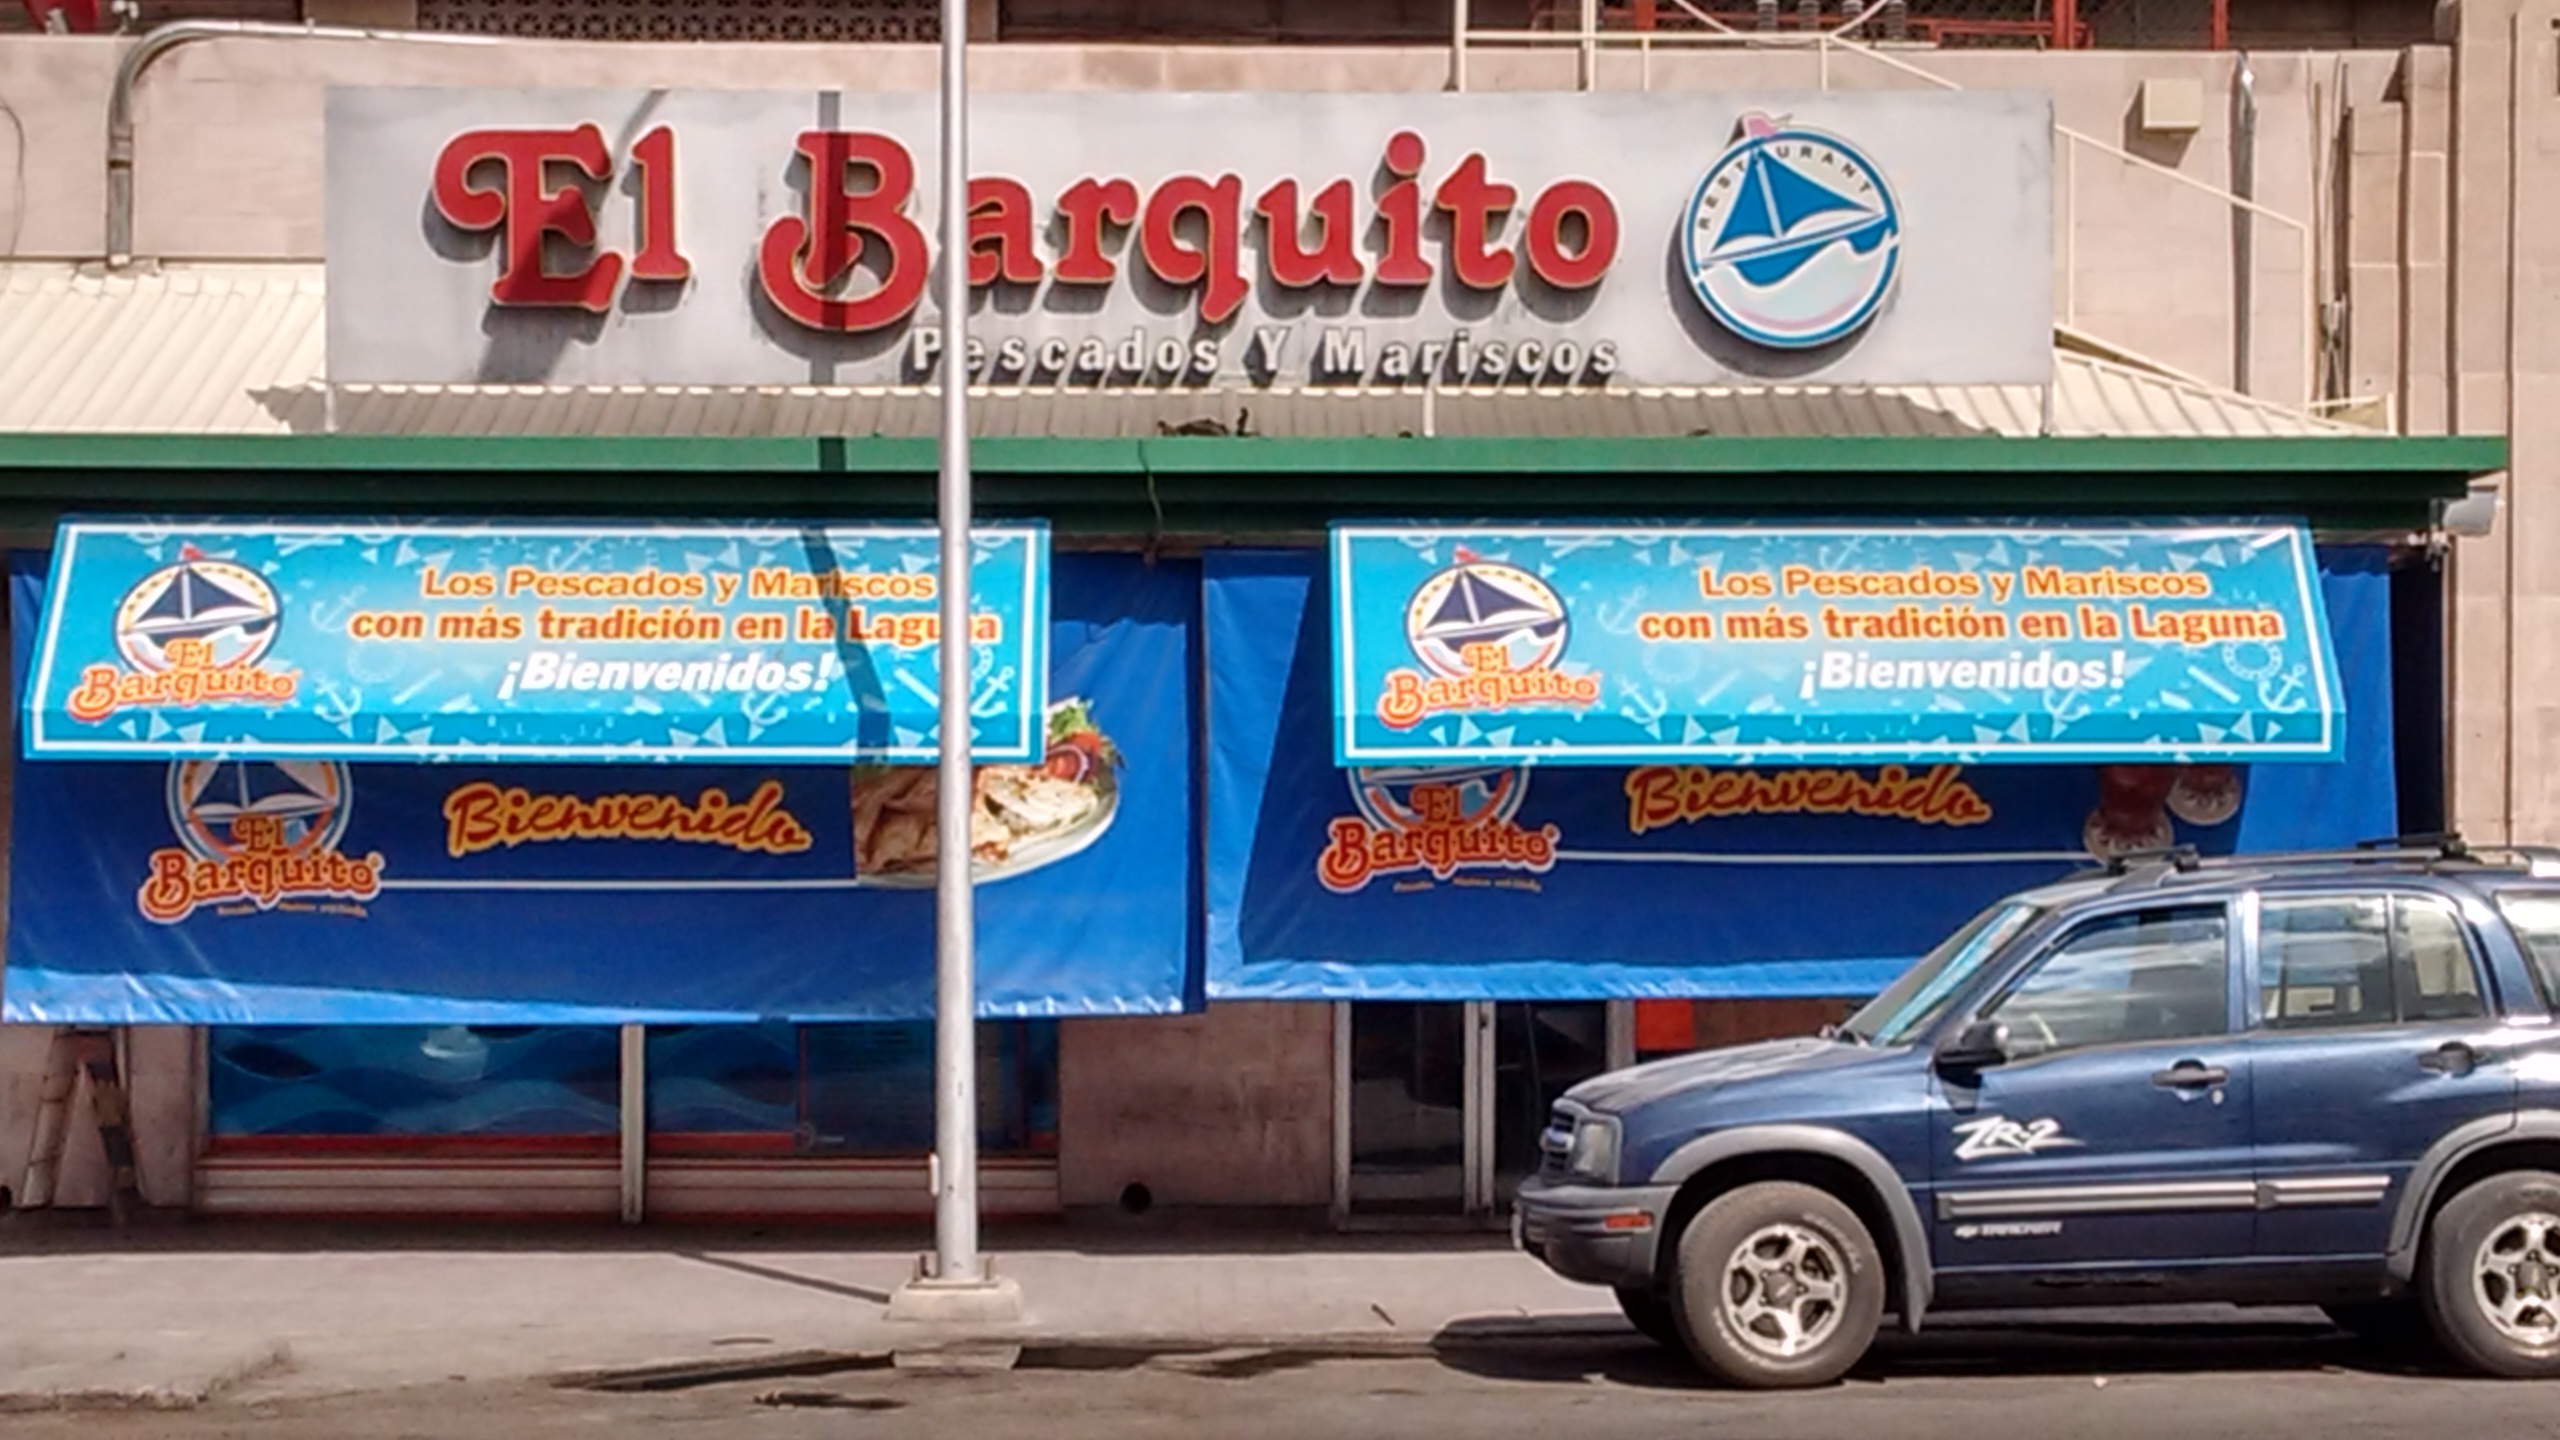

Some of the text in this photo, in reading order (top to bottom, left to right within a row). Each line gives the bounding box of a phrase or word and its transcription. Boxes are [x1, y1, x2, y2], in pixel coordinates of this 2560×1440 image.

[433, 123, 1618, 332] El Barquito
[914, 326, 1617, 374] Pescados Y Mariscos
[423, 567, 934, 603] Los Pescados y Mariscos
[1699, 566, 2208, 601] Los Pescados y Mariscos
[350, 605, 999, 648] con más tradición en la Lagua
[1639, 604, 2283, 645] con más tradición en la Laguna
[168, 641, 212, 670] El
[498, 650, 834, 700] ¡Bienvenidos!
[1462, 643, 1509, 673] El
[1800, 649, 2126, 699] ¡Bienvenidos!
[70, 664, 297, 721] Barquito
[1379, 667, 1599, 727] Barquito
[445, 782, 810, 855] Bienvenido
[1411, 785, 1463, 823] El
[1626, 765, 1990, 832] Bienvenido
[232, 814, 285, 852] El
[1319, 818, 1552, 892] Barquito
[141, 849, 378, 921] Barquito
[1951, 1115, 2088, 1161] ZR-2
